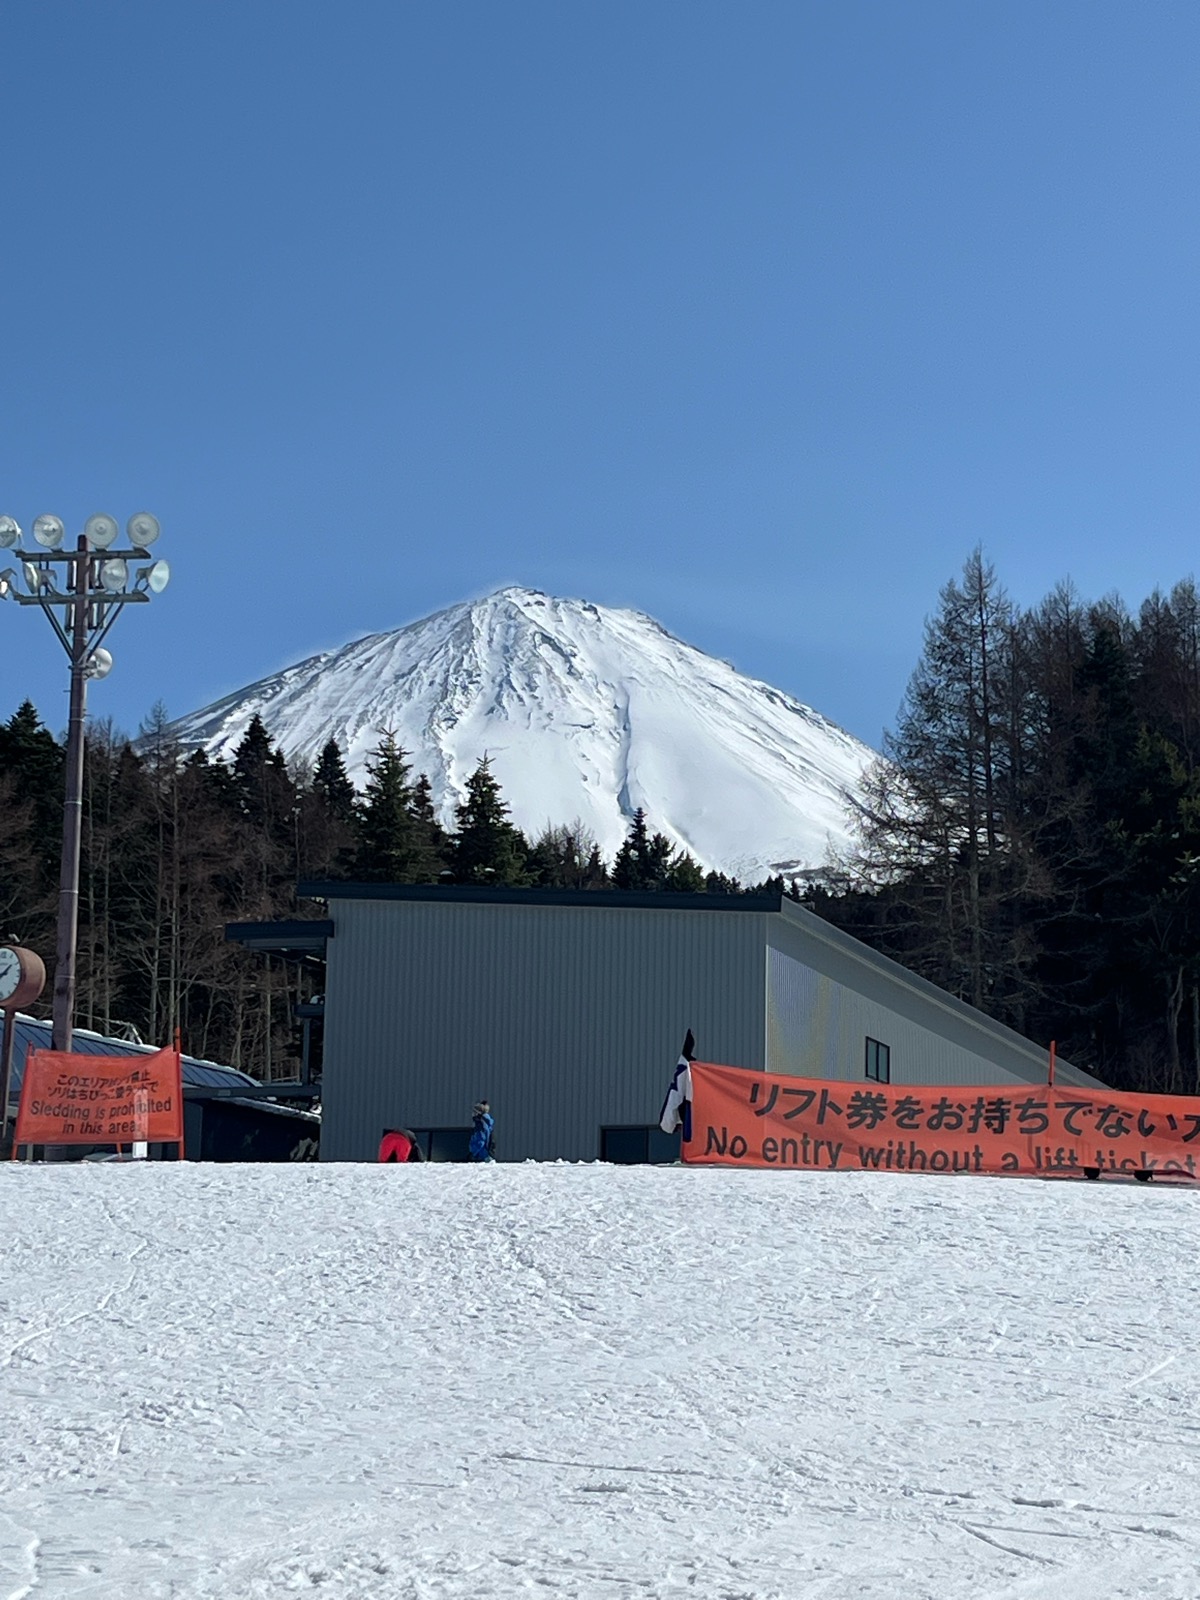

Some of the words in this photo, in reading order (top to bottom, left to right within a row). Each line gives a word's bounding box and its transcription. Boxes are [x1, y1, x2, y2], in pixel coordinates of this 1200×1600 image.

[31, 1100, 90, 1120] Sledding
[95, 1106, 105, 1119] is
[109, 1097, 172, 1119] prohibited
[62, 1120, 75, 1134] in
[80, 1120, 103, 1135] this
[704, 1126, 747, 1159] No
[762, 1132, 843, 1168] entry
[859, 1140, 983, 1171] without
[1001, 1153, 1018, 1170] a
[1035, 1146, 1078, 1169] lift
